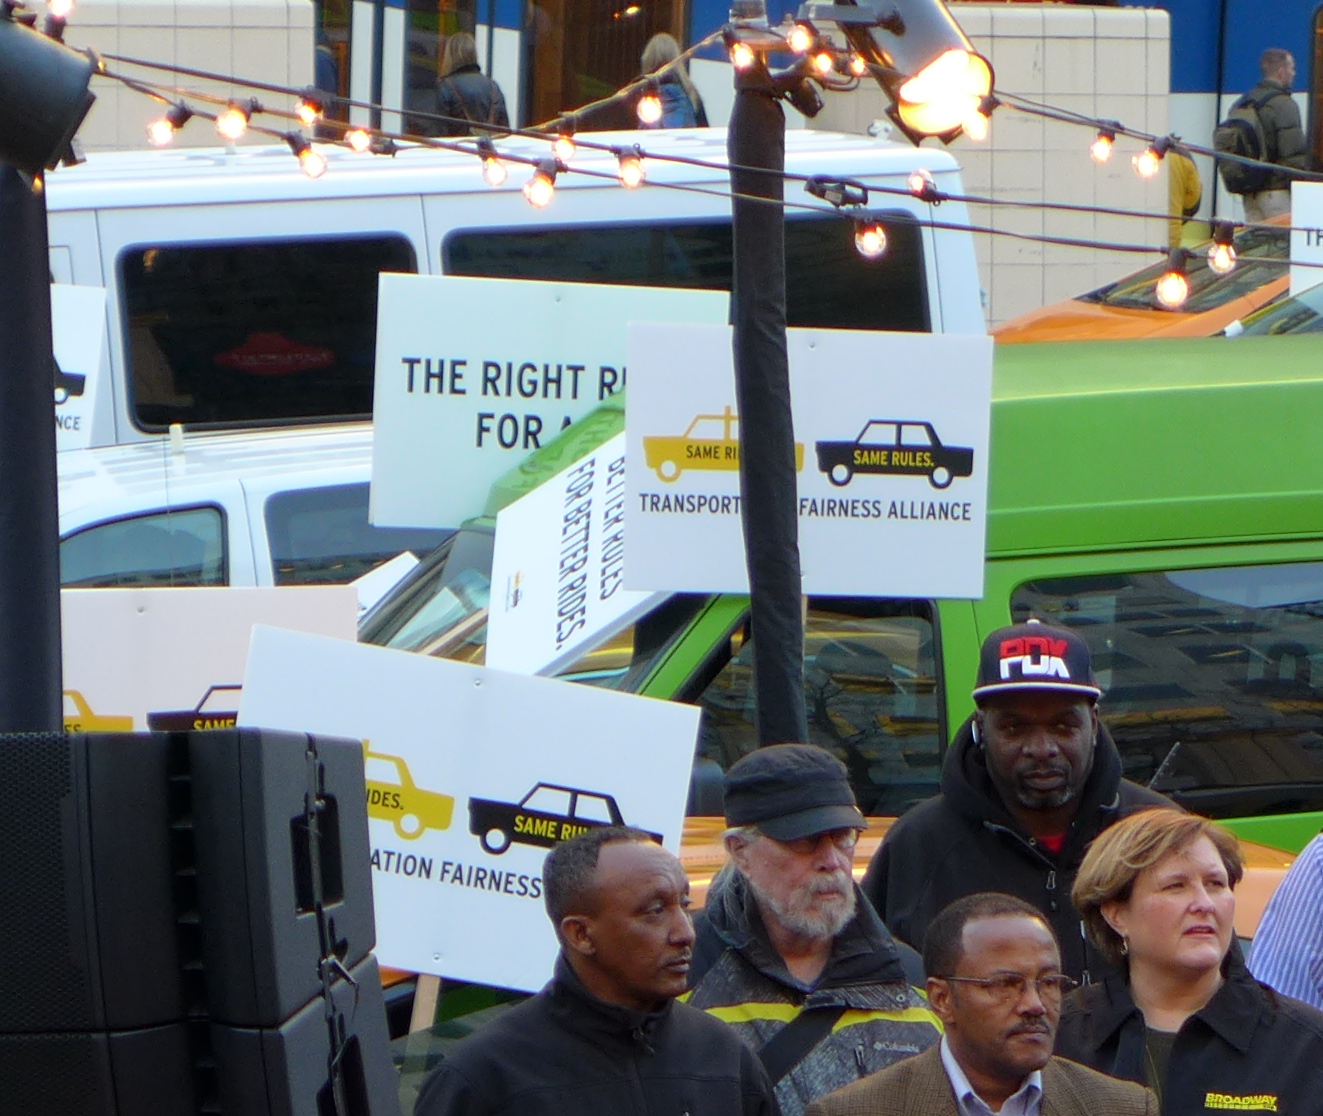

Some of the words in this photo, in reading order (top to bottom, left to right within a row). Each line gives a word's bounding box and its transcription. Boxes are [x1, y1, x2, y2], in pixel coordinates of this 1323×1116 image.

[401, 356, 468, 396] THE
[481, 361, 586, 401] RIGHT
[476, 411, 543, 450] FOR
[686, 444, 721, 461] SAME
[724, 445, 740, 461] RI
[853, 449, 890, 467] SAME
[891, 450, 936, 469] RULES.
[564, 457, 596, 509] FOR
[638, 493, 741, 516] TRANSPORT
[799, 498, 883, 519] FAIRNESS
[887, 500, 973, 522] ALLIANCE
[557, 498, 593, 584] BETTER
[999, 636, 1071, 680] PDX
[366, 787, 405, 811] IDES.
[513, 815, 557, 840] SAME
[371, 846, 434, 880] ATION
[439, 861, 544, 899] FAIRNESS
[1205, 1092, 1278, 1105] BROADWAY
